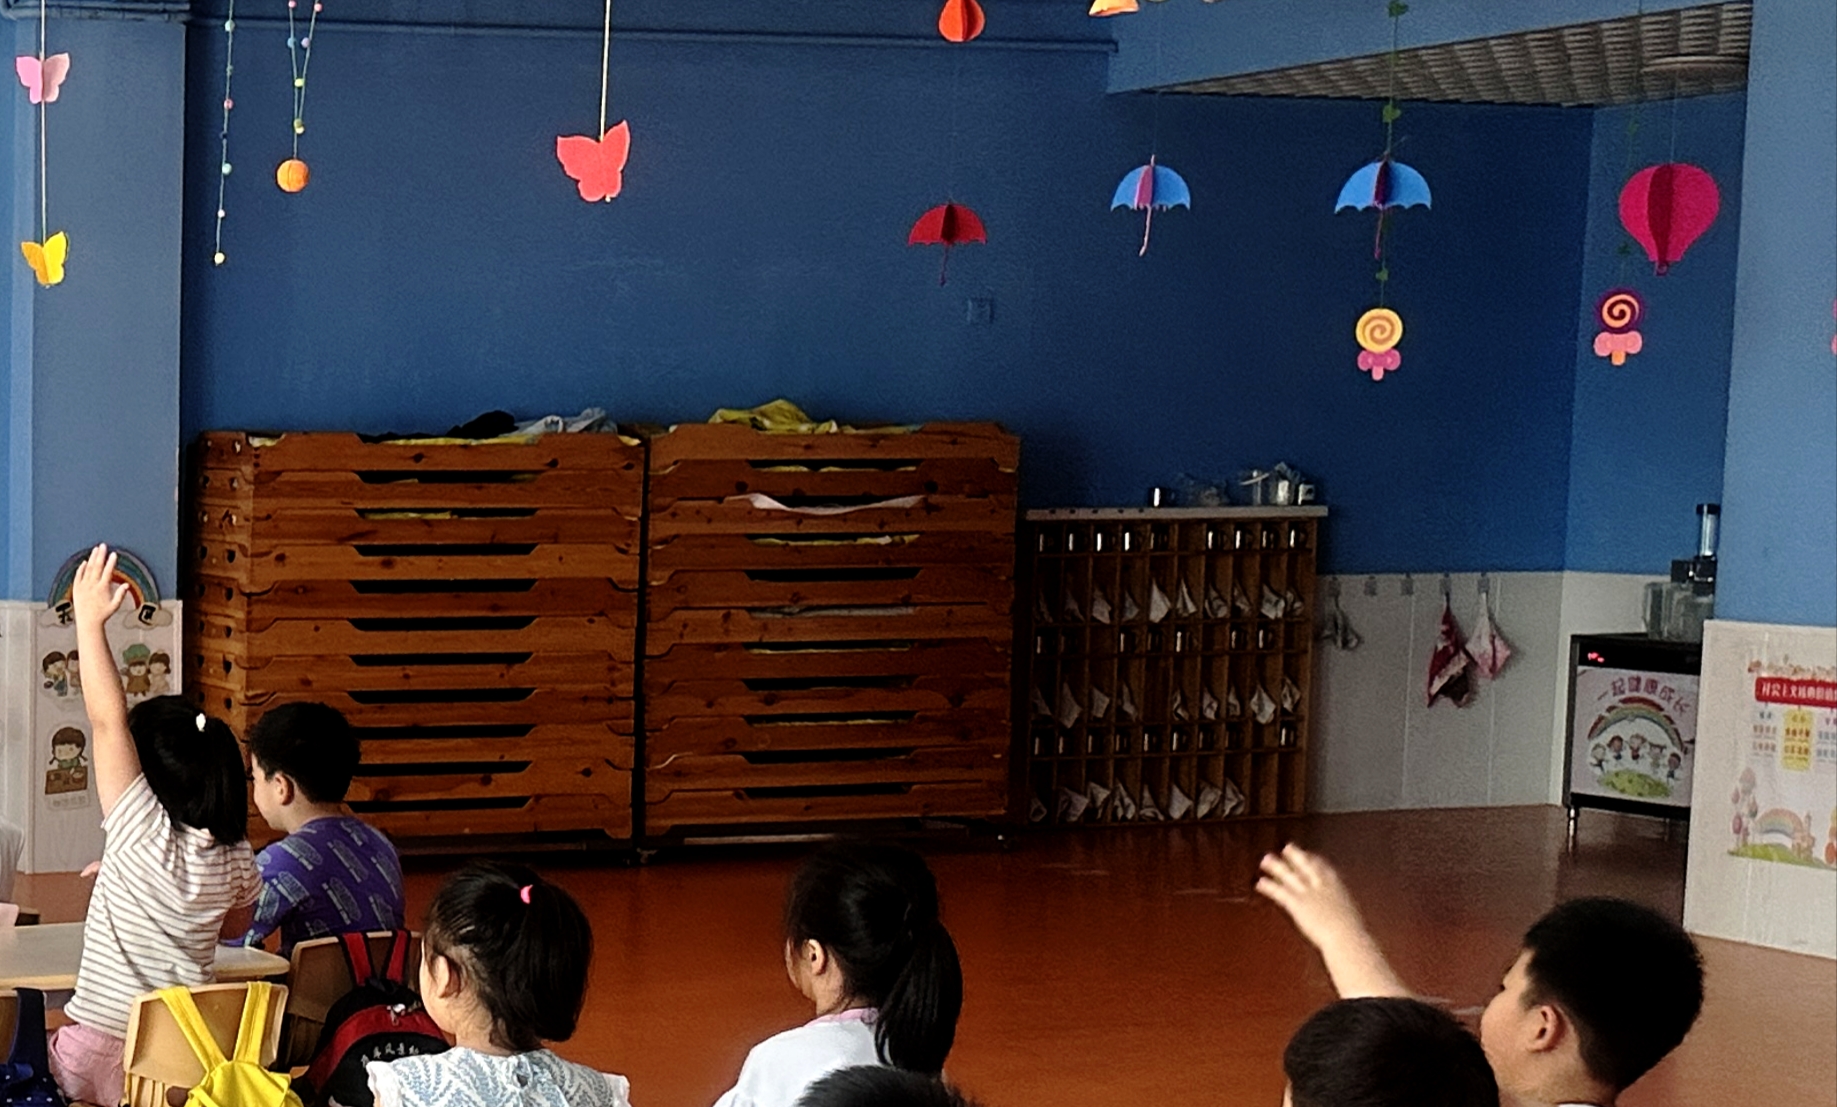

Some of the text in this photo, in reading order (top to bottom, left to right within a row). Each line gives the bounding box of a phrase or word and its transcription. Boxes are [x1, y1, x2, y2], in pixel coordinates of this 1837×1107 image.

[1597, 676, 1690, 717] 一起健康成长
